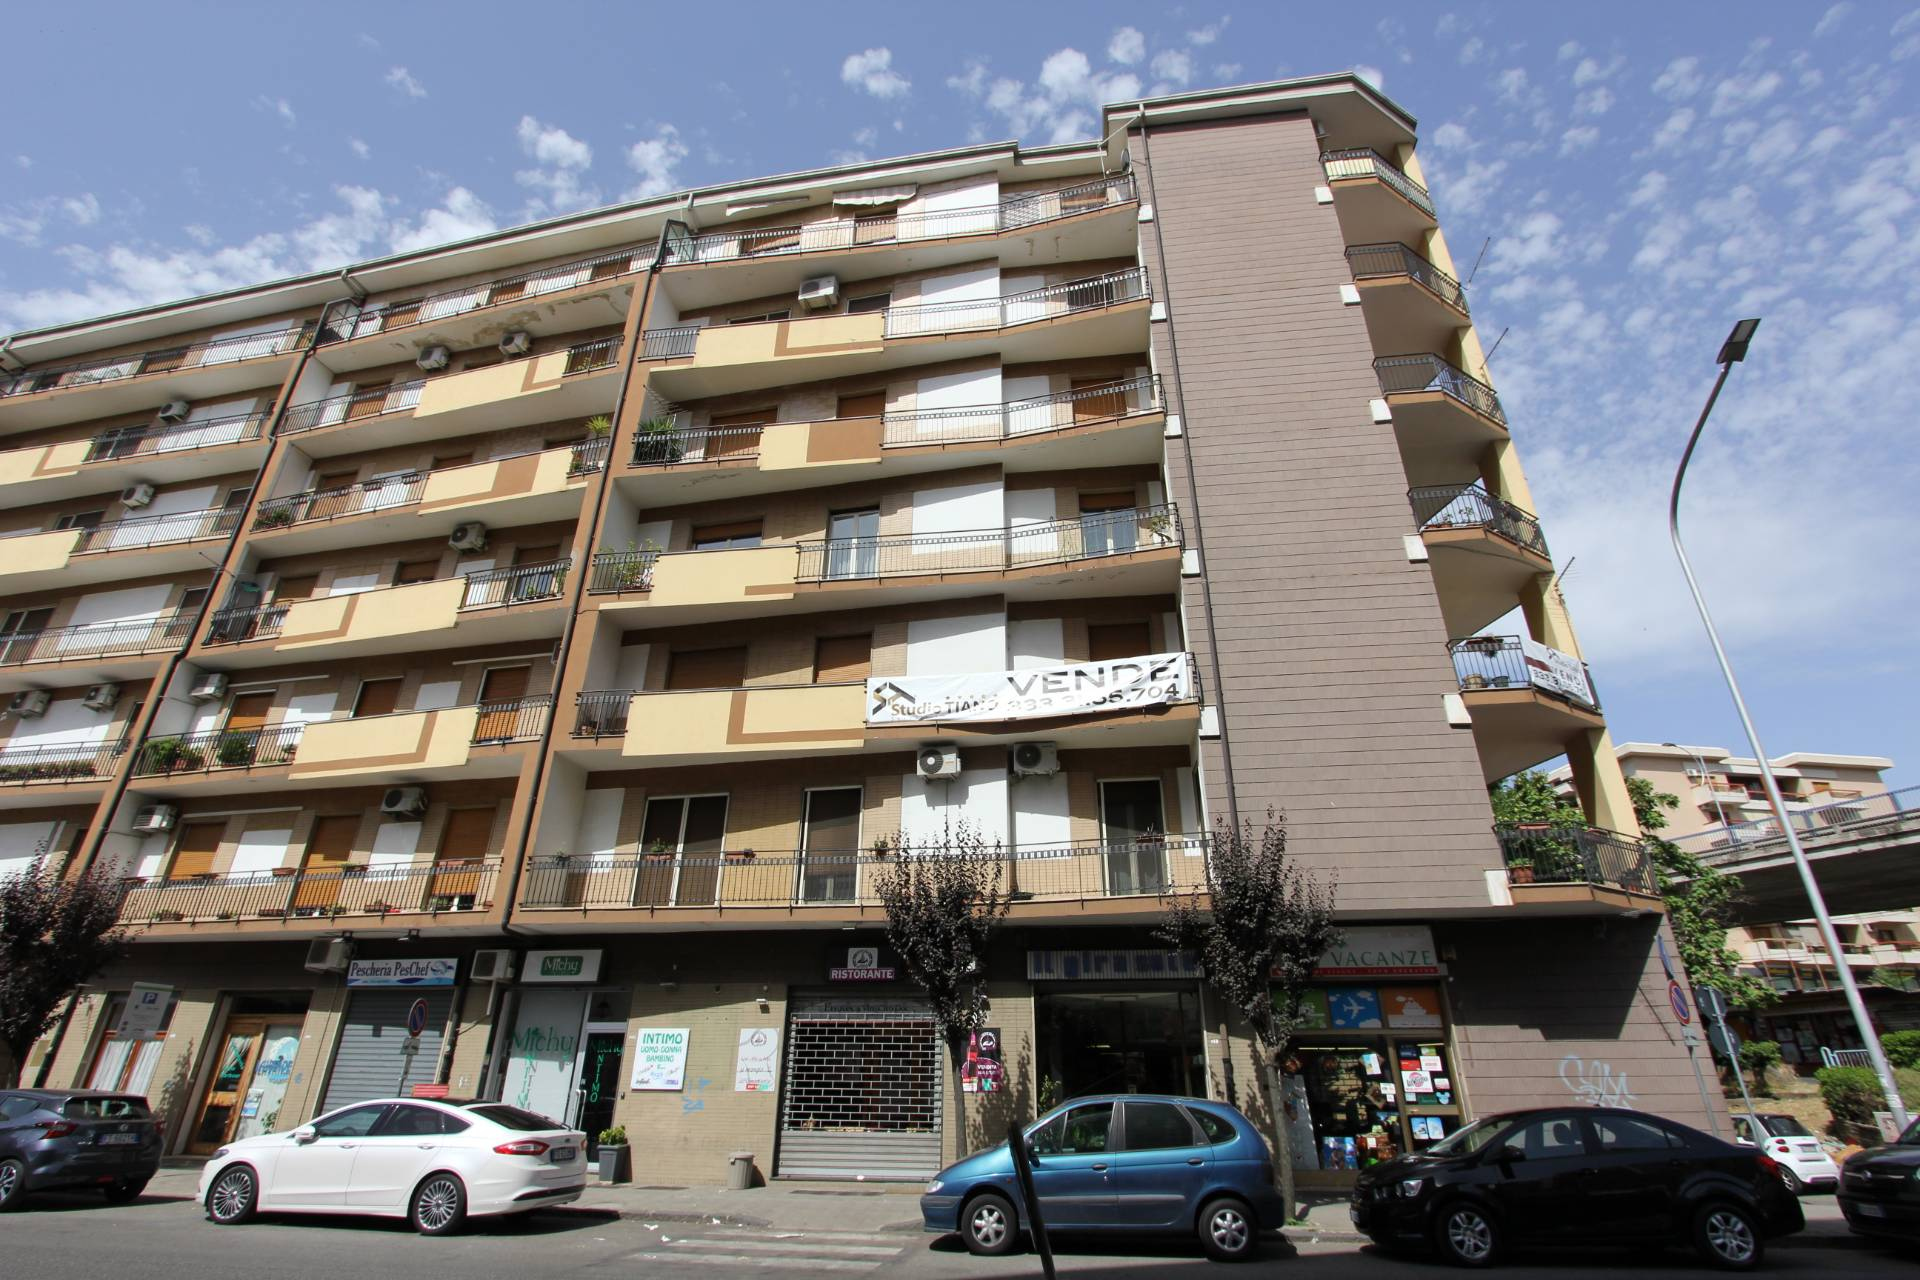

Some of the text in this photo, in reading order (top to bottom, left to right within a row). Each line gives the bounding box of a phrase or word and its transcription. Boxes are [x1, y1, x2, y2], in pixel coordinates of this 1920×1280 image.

[1007, 657, 1180, 697] VENDE
[890, 701, 942, 716] Studio
[545, 957, 580, 974] Michy
[1331, 951, 1433, 966] VACANZE
[351, 961, 431, 977] Pescheria PesChef
[831, 969, 894, 979] RISTORANTE
[511, 1026, 575, 1061] Michy
[643, 1033, 683, 1044] INTIMO
